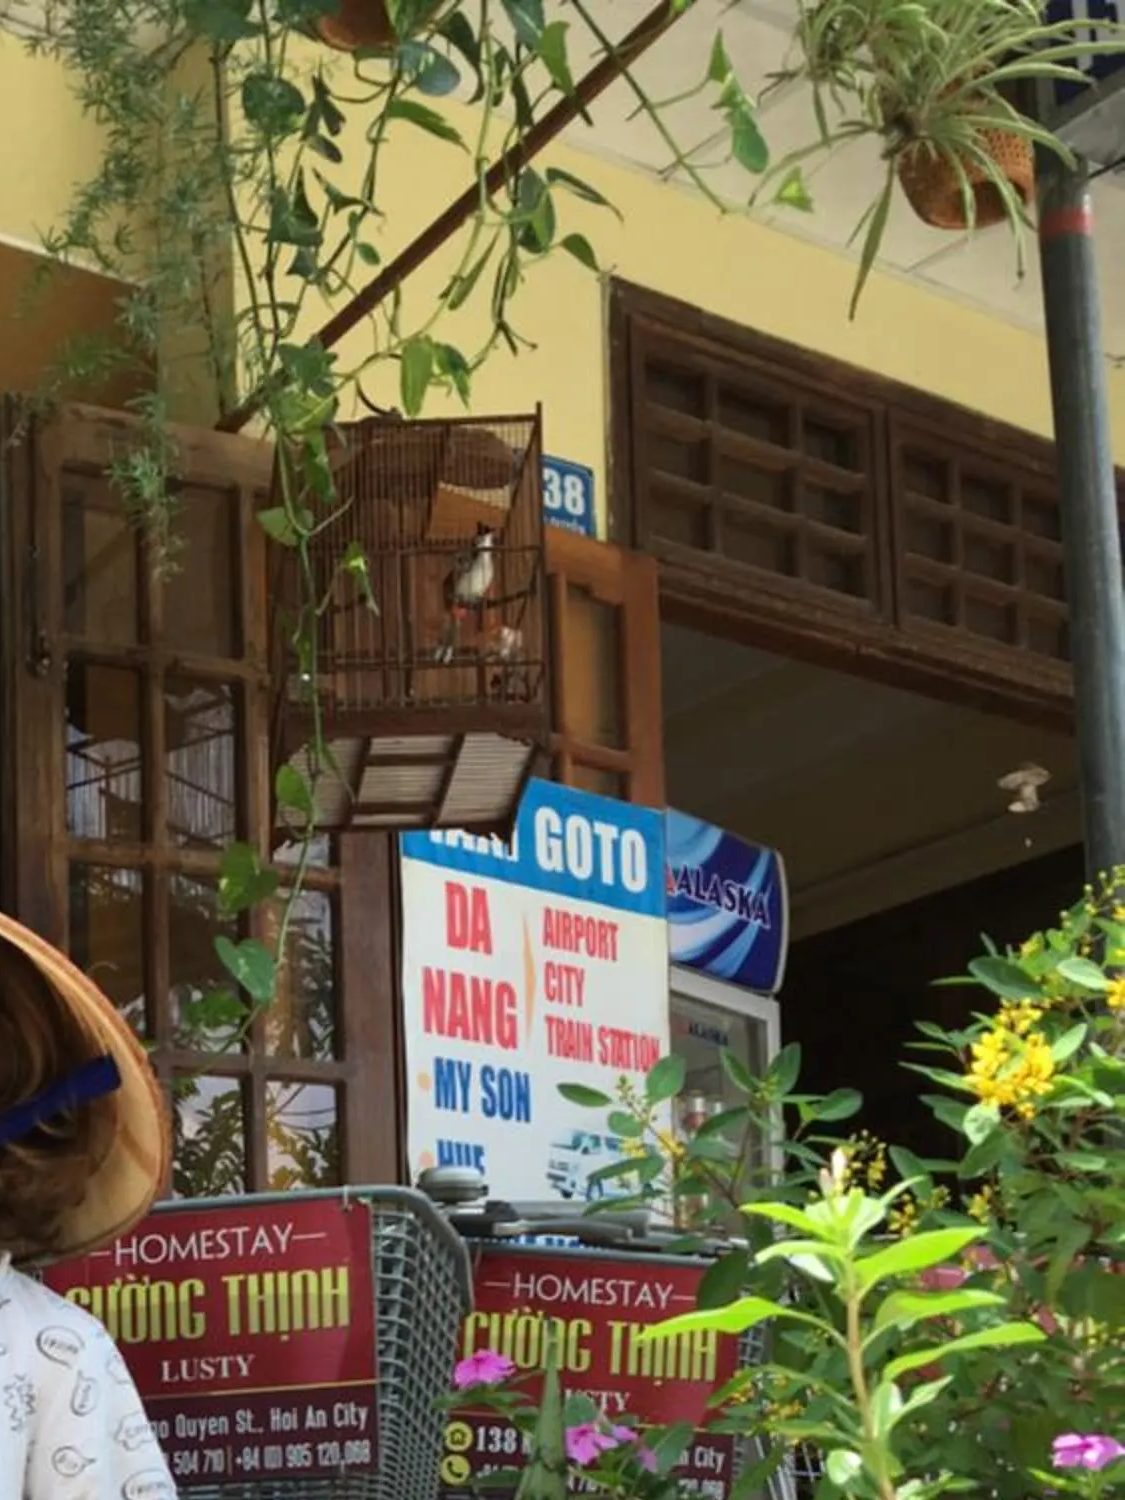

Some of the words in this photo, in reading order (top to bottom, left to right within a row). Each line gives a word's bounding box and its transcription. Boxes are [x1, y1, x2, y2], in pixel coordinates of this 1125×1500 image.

[534, 806, 648, 893] GOTO
[445, 879, 493, 956] DA
[676, 864, 771, 928] ALASKA
[543, 906, 619, 963] AIRPORT
[422, 965, 518, 1050] NANG
[544, 961, 584, 1007] CITY
[544, 1014, 594, 1063] TRAIN
[597, 1025, 661, 1073] STATION
[435, 1056, 472, 1113] MY
[480, 1064, 531, 1123] SON
[115, 1222, 293, 1267] HOMESTAY
[514, 1271, 674, 1310] HOMESTAY
[162, 1353, 255, 1382] LUSTY
[175, 1412, 231, 1442] Quyen
[270, 1407, 298, 1432] Hoi
[304, 1404, 329, 1429] An
[333, 1402, 369, 1432] City
[476, 1426, 517, 1454] 138
[695, 1444, 726, 1475] City
